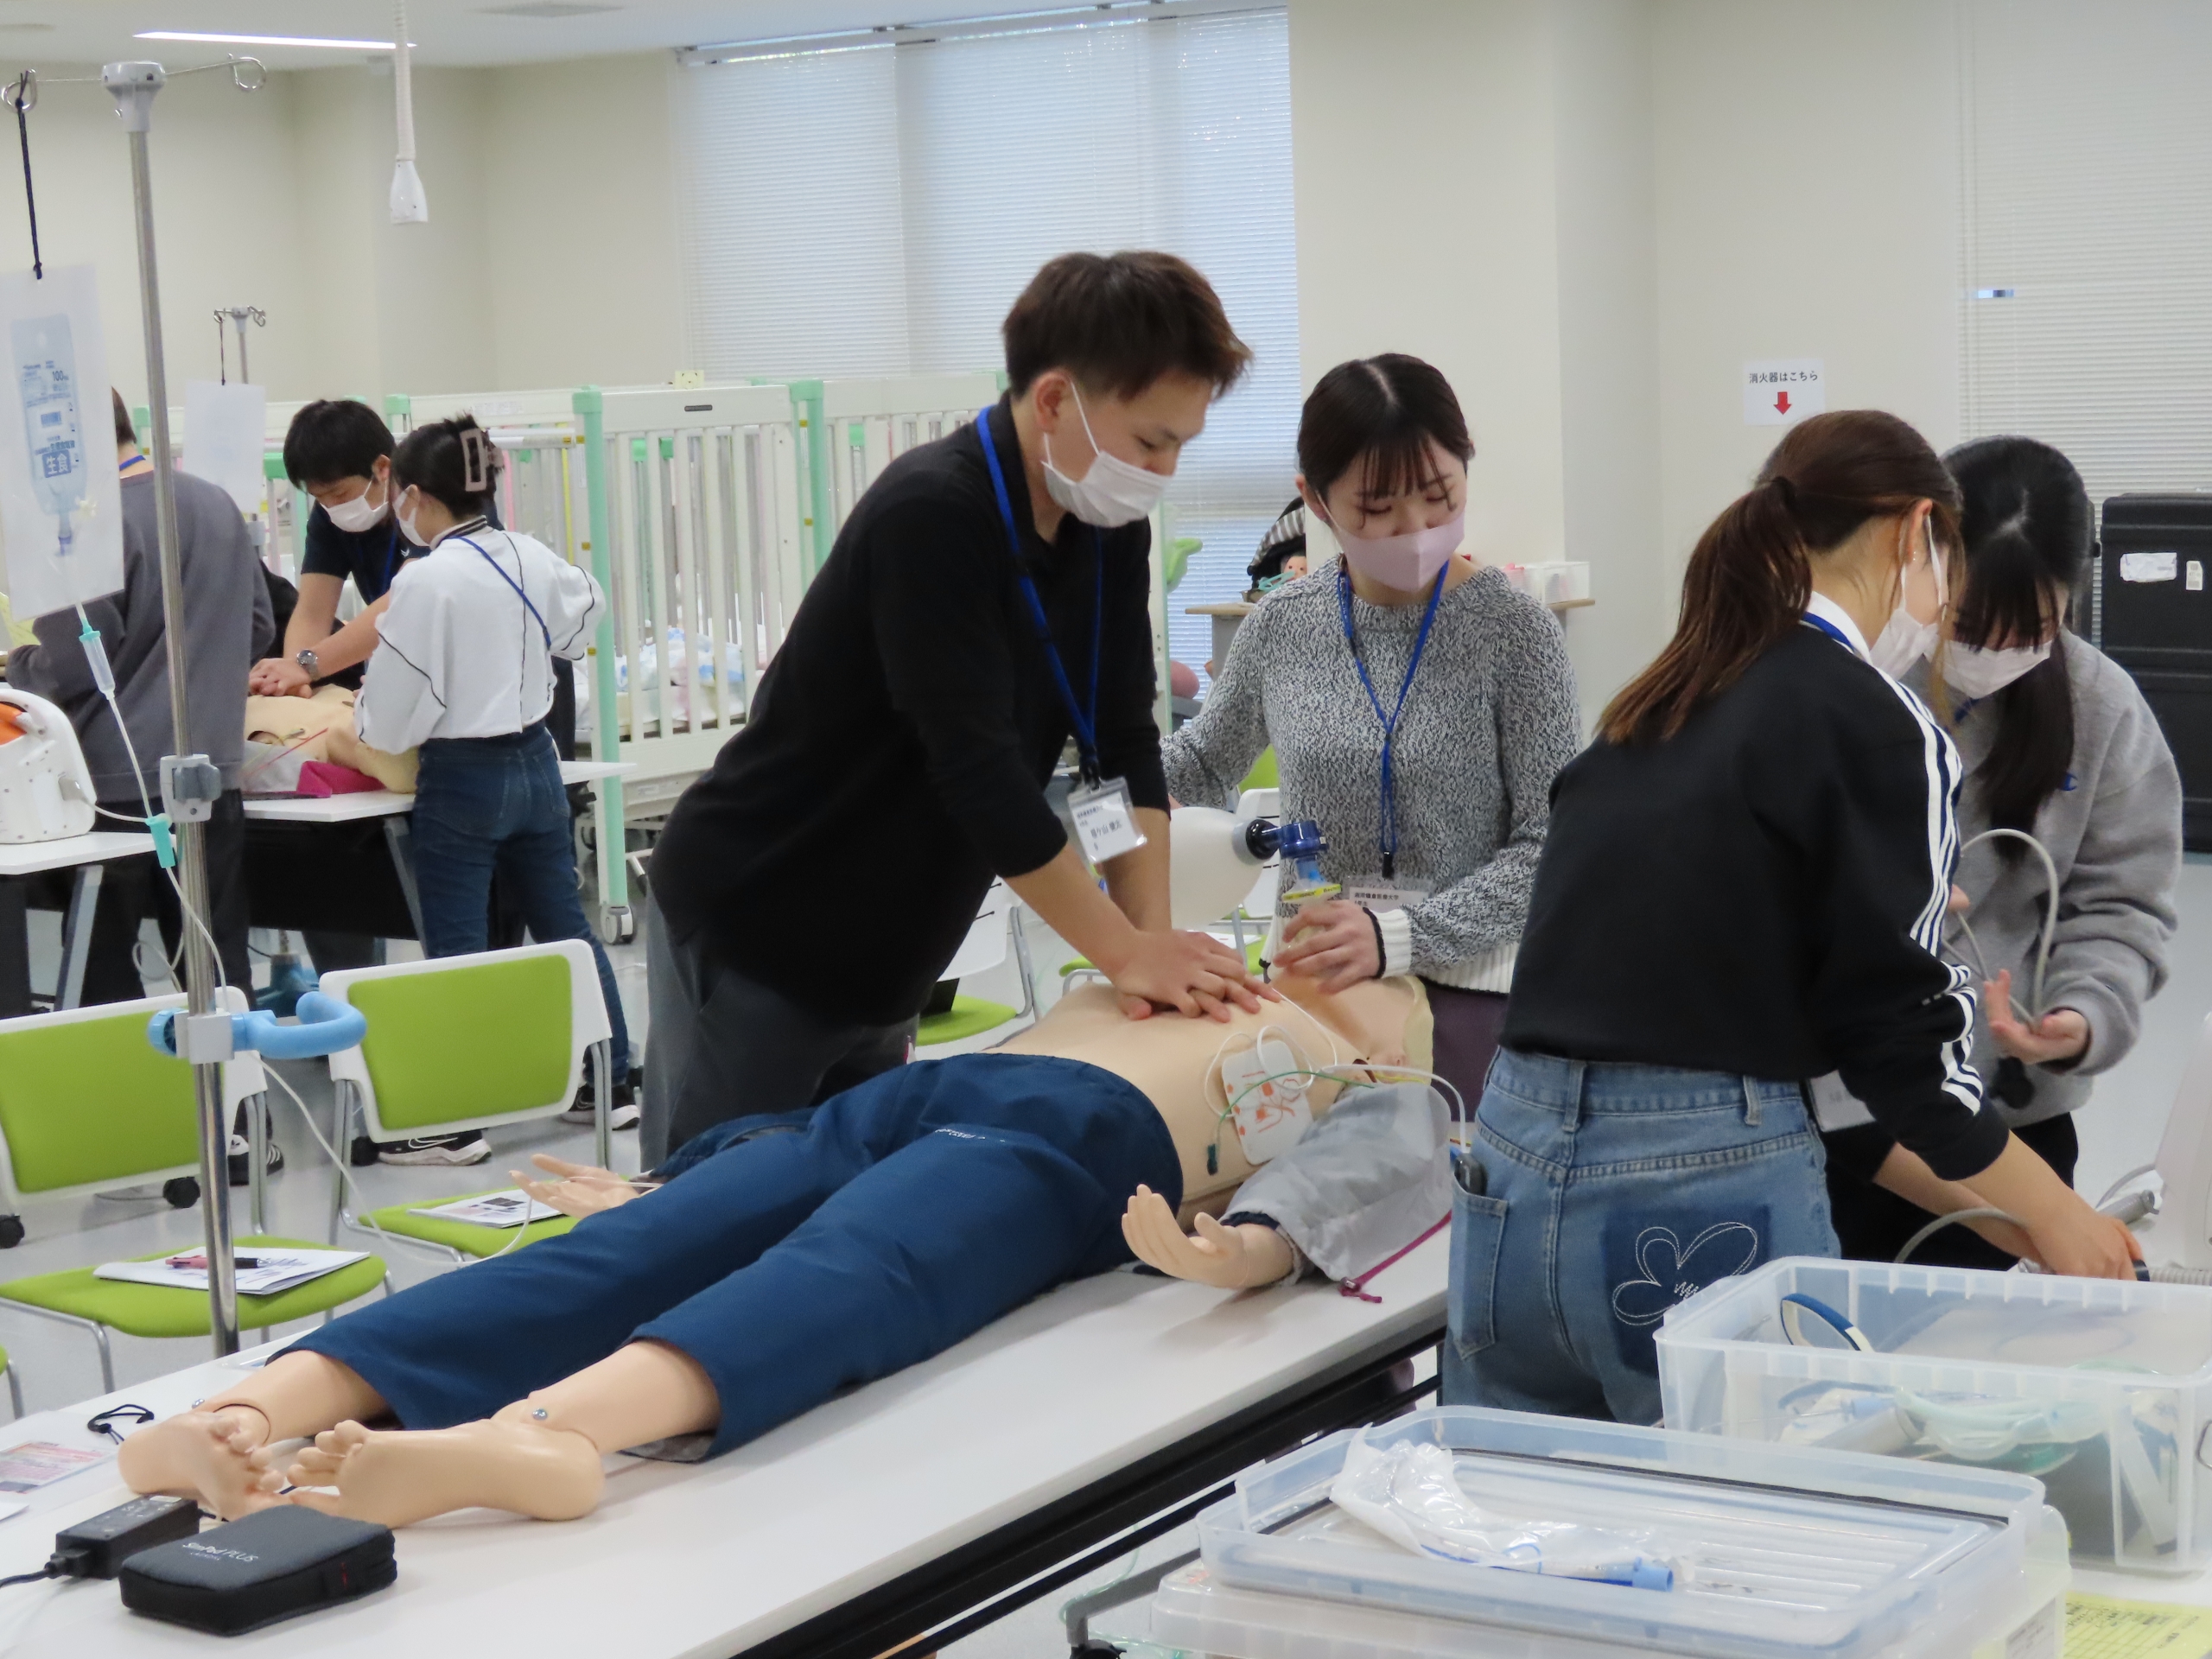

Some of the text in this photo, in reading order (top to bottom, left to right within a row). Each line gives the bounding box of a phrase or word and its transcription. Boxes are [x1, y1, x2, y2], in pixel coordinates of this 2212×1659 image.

[1749, 371, 1818, 384] 消火器はこちら
[46, 453, 69, 476] 生食
